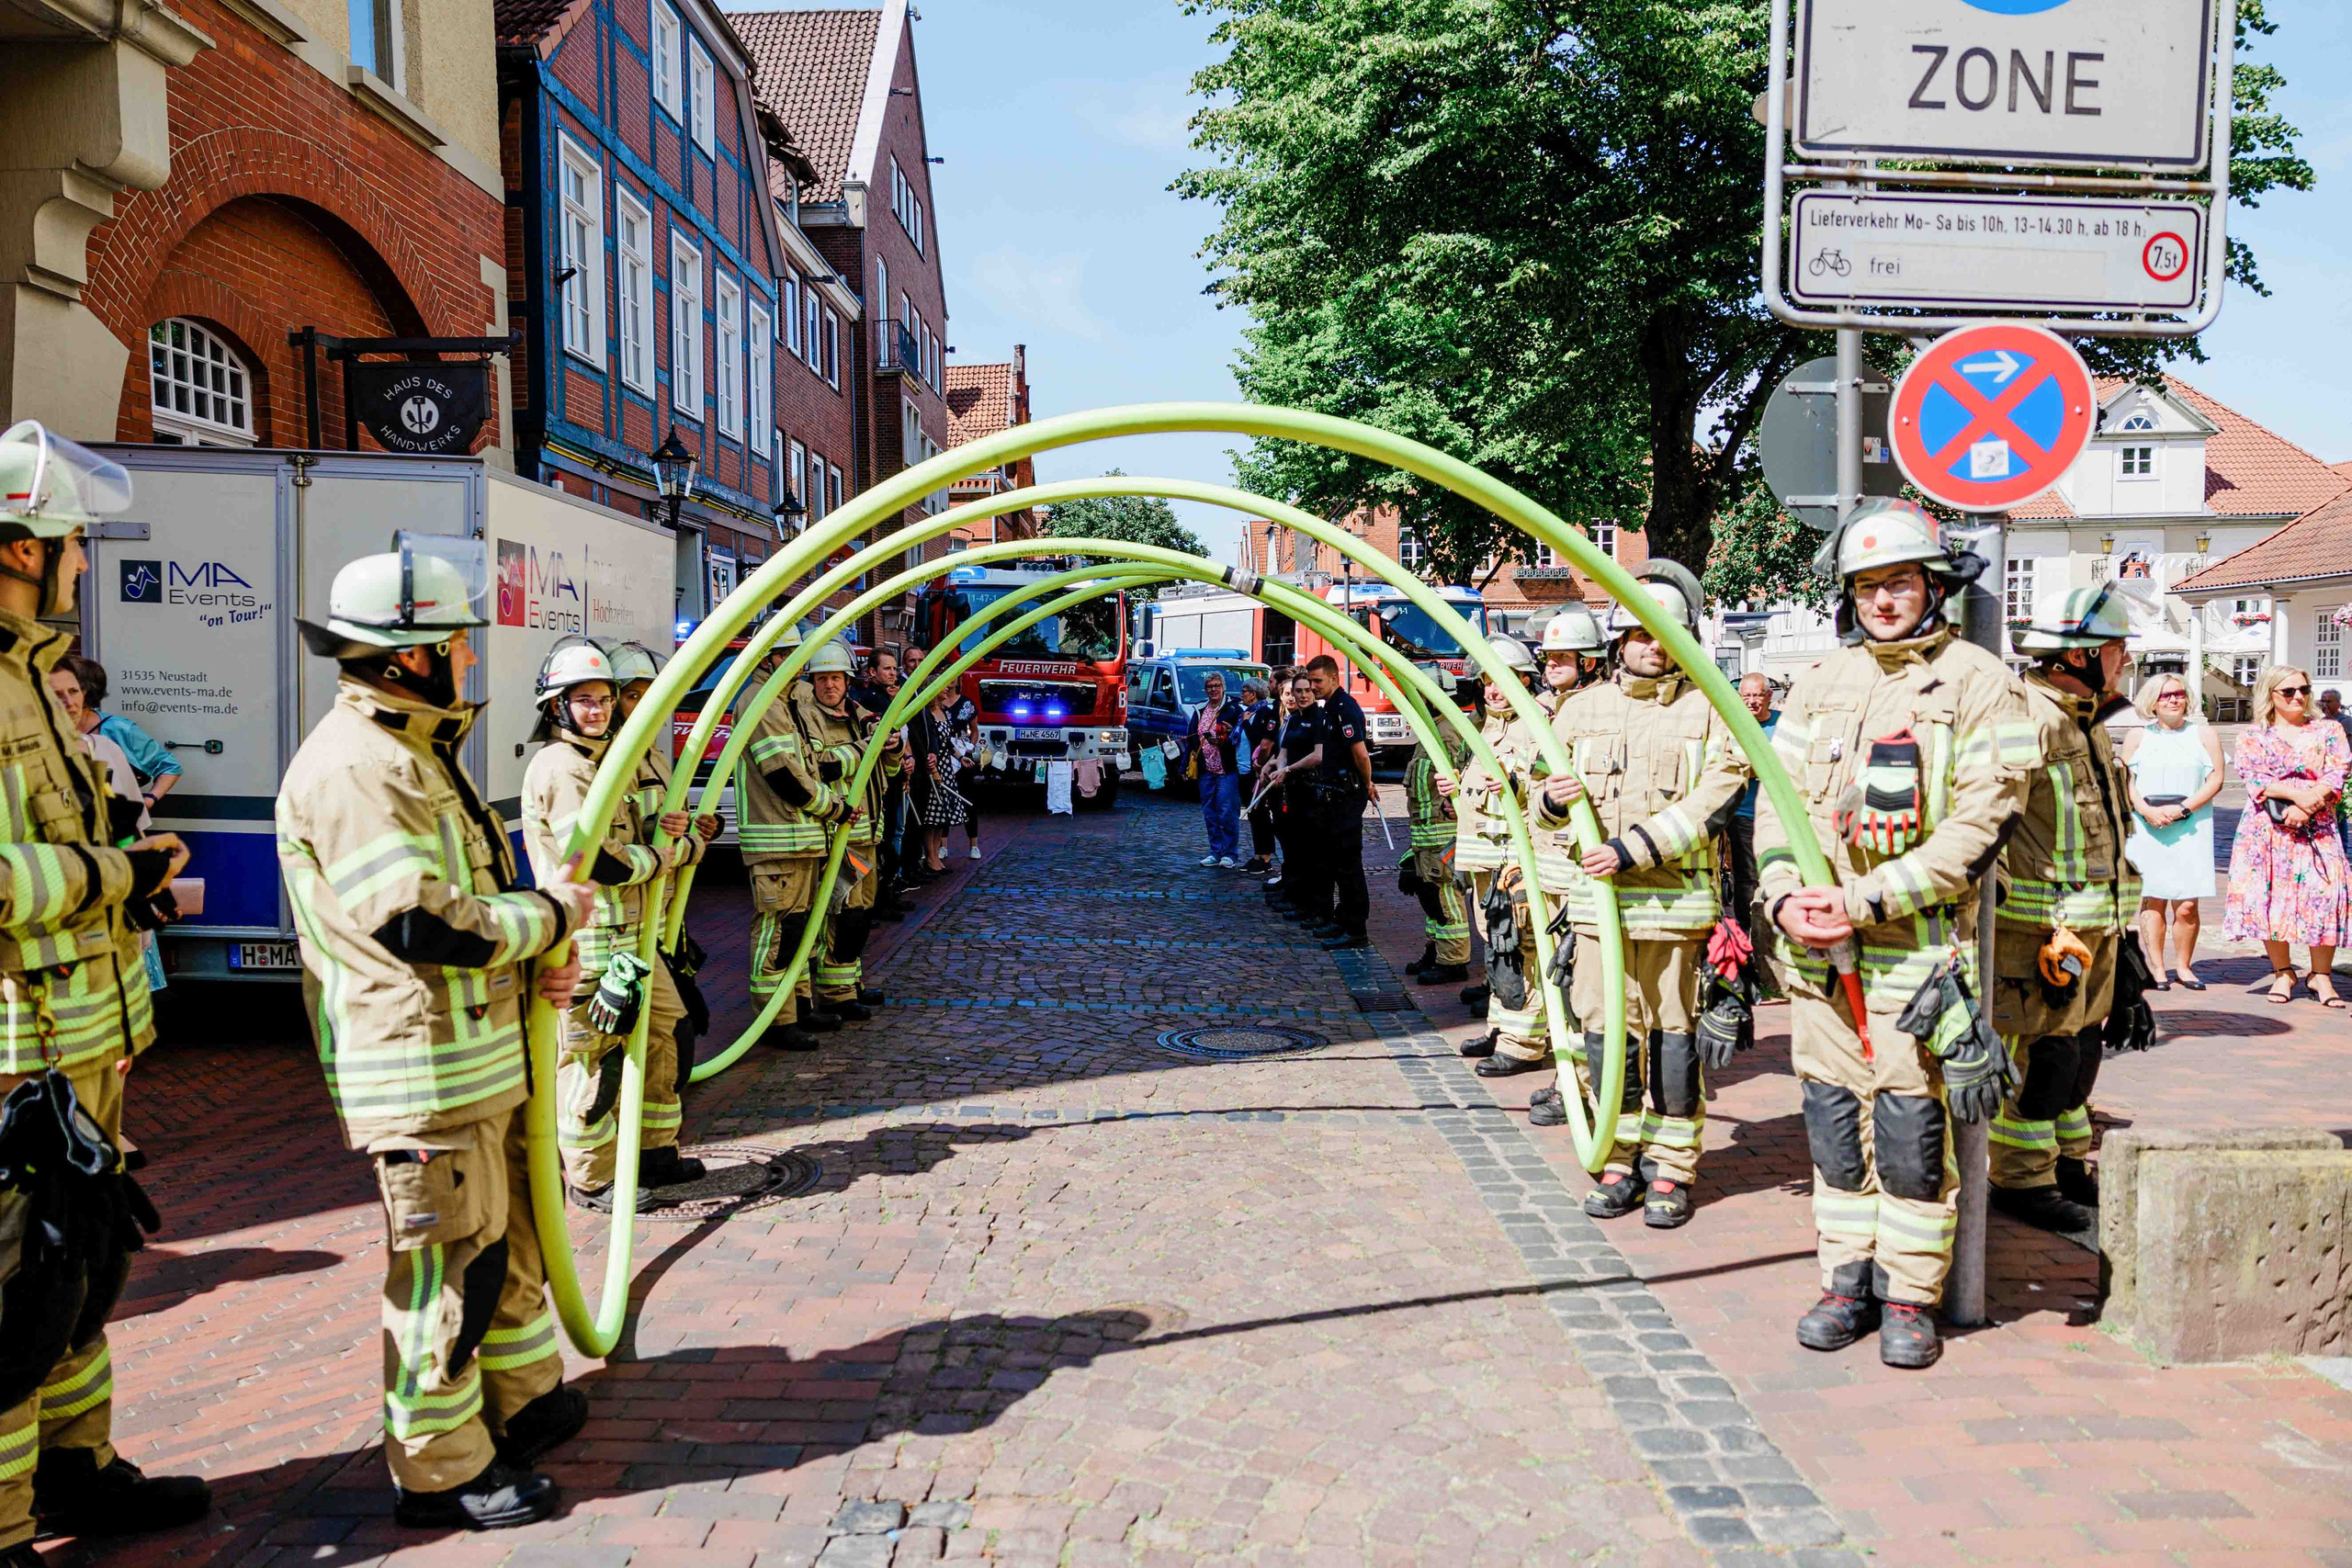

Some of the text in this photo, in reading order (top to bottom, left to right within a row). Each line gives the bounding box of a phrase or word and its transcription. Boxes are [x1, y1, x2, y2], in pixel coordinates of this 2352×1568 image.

[1908, 44, 2104, 116] ZONE
[1811, 209, 1899, 229] Lieferverkehr
[1905, 213, 1930, 230] Mo-
[1937, 214, 1951, 231] Sa
[1957, 215, 1975, 231] bis
[2015, 217, 2073, 234] 13-14.30
[2094, 220, 2109, 236] ab
[2116, 220, 2129, 236] 18
[1870, 257, 1900, 274] frei
[383, 376, 453, 400] HAUS DES
[380, 424, 461, 452] HANDWERKS
[169, 561, 253, 588] MA
[530, 546, 580, 602] MA
[169, 589, 255, 607] Events
[529, 600, 581, 634] Events
[120, 671, 209, 682] 31535 Neustadt
[999, 660, 1078, 675] FEUERWEHR
[121, 685, 232, 698] www.events-ma.de
[121, 700, 239, 715] info@events-ma.de
